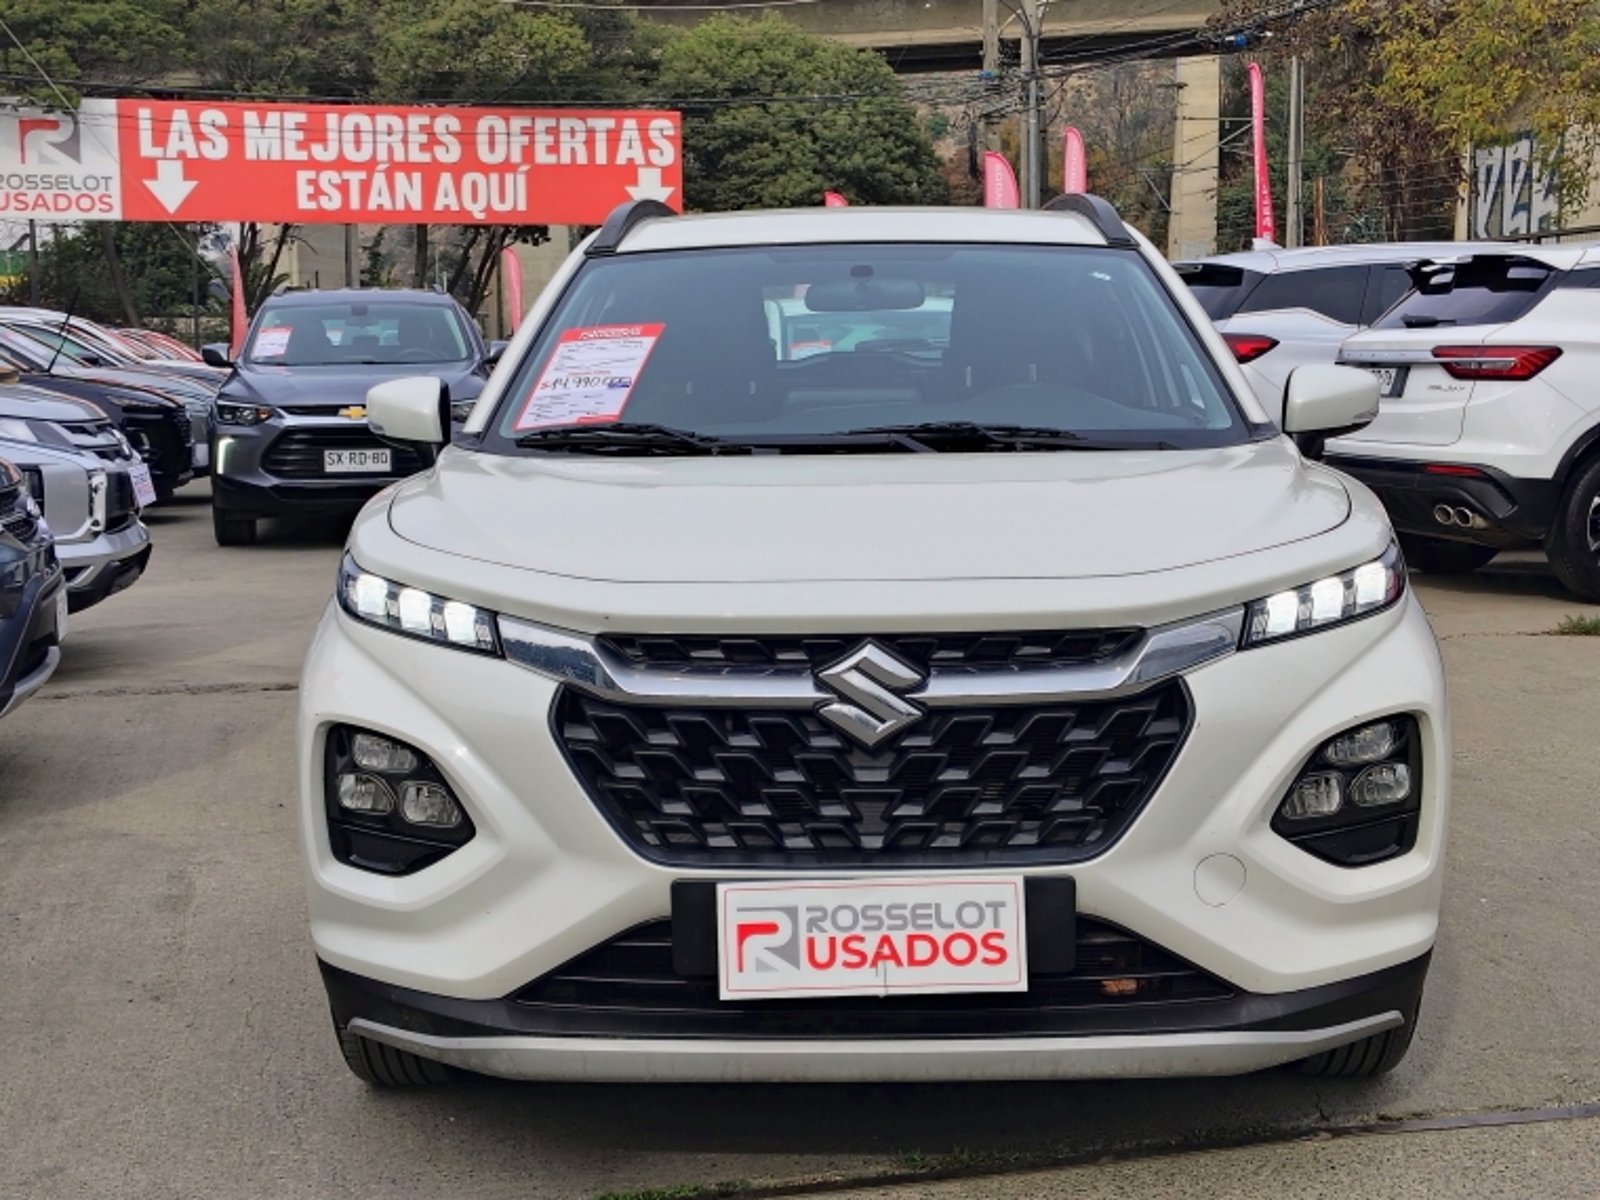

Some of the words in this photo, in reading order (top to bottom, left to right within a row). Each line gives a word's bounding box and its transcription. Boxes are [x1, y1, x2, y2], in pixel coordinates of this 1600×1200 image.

[138, 107, 229, 160] LAS
[243, 110, 462, 165] MEJORES
[475, 115, 676, 167] OFERTAS
[296, 163, 422, 212] ESTÁN
[433, 164, 531, 219] AQUÍ
[805, 900, 1007, 933] ROSSELOT
[805, 931, 1009, 971] USADOS
